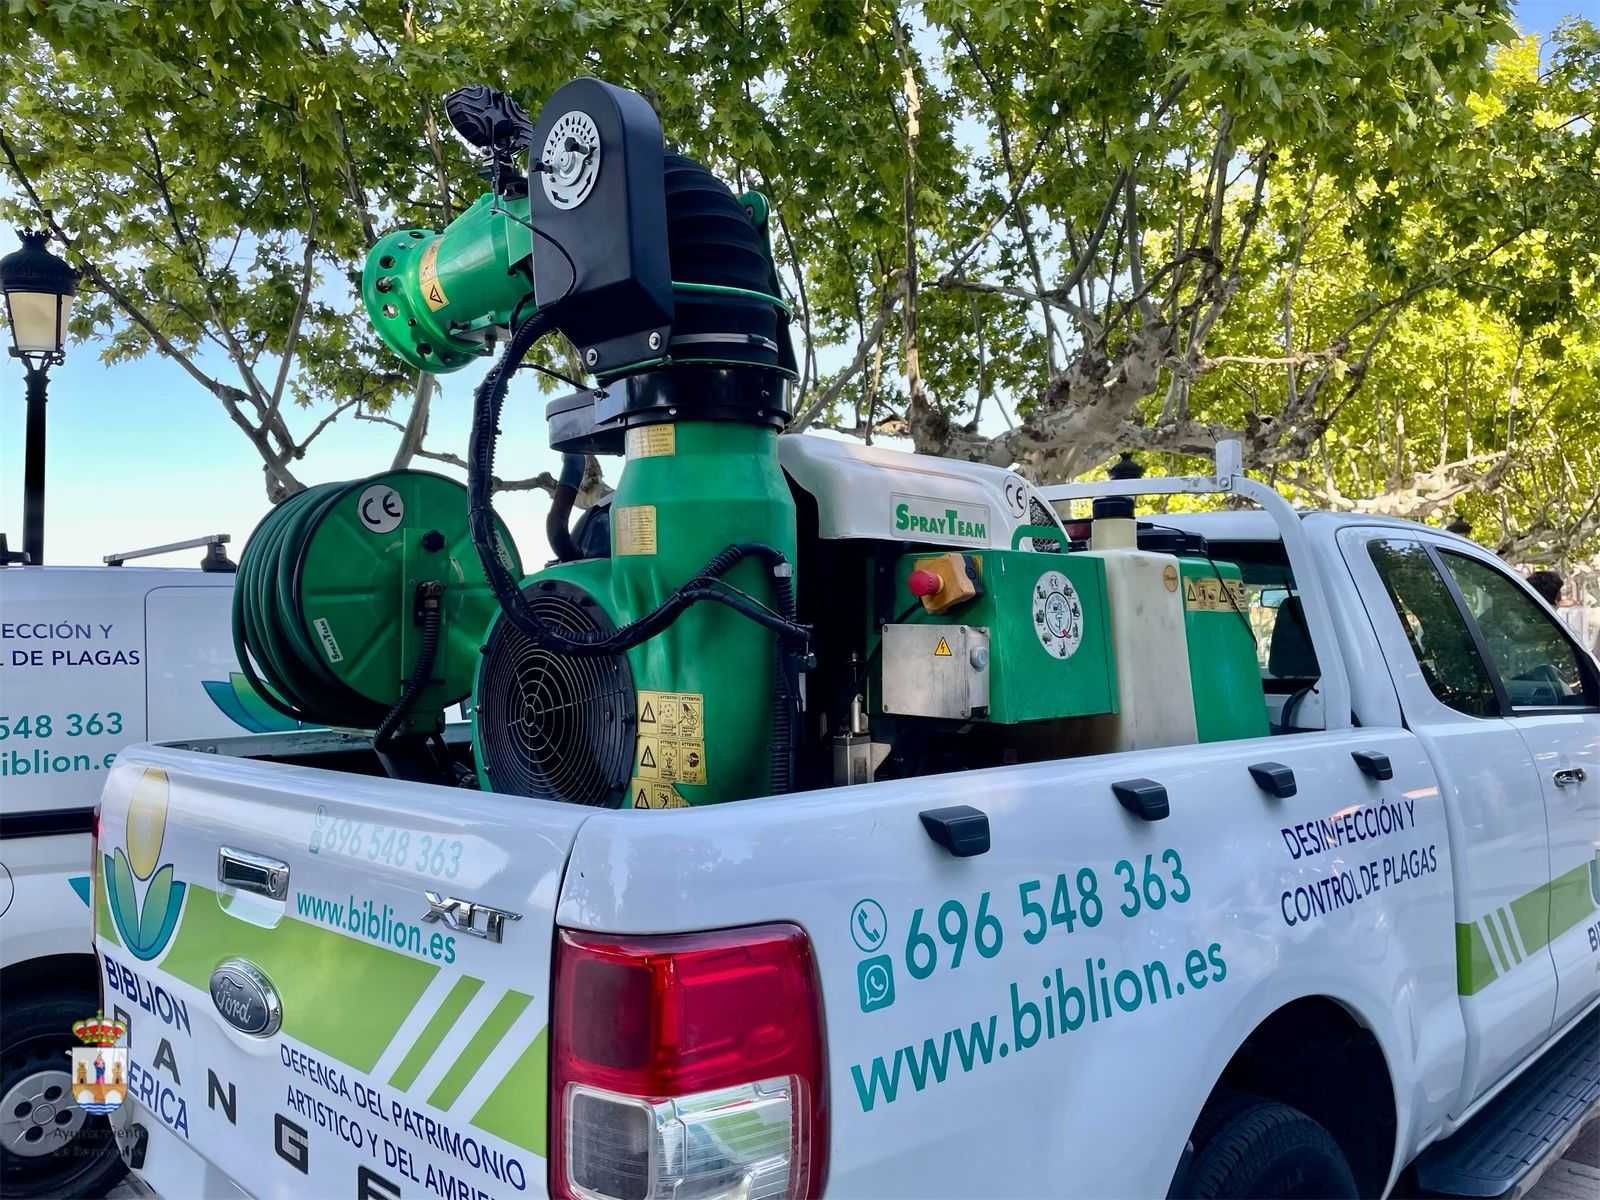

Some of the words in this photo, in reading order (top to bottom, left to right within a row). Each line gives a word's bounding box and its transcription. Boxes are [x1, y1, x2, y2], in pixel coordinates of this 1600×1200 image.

[12, 650, 44, 666] DE
[52, 649, 140, 666] PLAGAS
[99, 624, 113, 638] Y
[66, 712, 122, 737] 363
[324, 819, 362, 856] 696
[368, 829, 409, 867] 548
[415, 836, 464, 877] 363
[1281, 798, 1404, 860] DESINFECCIÓN
[1405, 799, 1415, 828] Y
[421, 890, 523, 944] XLT
[905, 891, 1004, 980] 696
[1019, 868, 1103, 945] 548
[1114, 849, 1191, 918] 363
[1281, 871, 1362, 927] CONTROL
[1360, 861, 1381, 896] DE
[1383, 844, 1438, 888] PLAGAS
[296, 892, 457, 964] www.biblion.es
[103, 954, 192, 1039] BIBLION
[215, 975, 254, 1024] Ford
[850, 943, 1227, 1113] www.biblion.es
[128, 1060, 189, 1140] ERICA
[280, 1043, 352, 1102] DEFENSA
[353, 1082, 389, 1122] DEL
[391, 1101, 527, 1191] PATRIMONIO
[287, 1084, 363, 1149] ARTISTICO
[366, 1129, 378, 1158] Y
[384, 1139, 420, 1183] DEL
